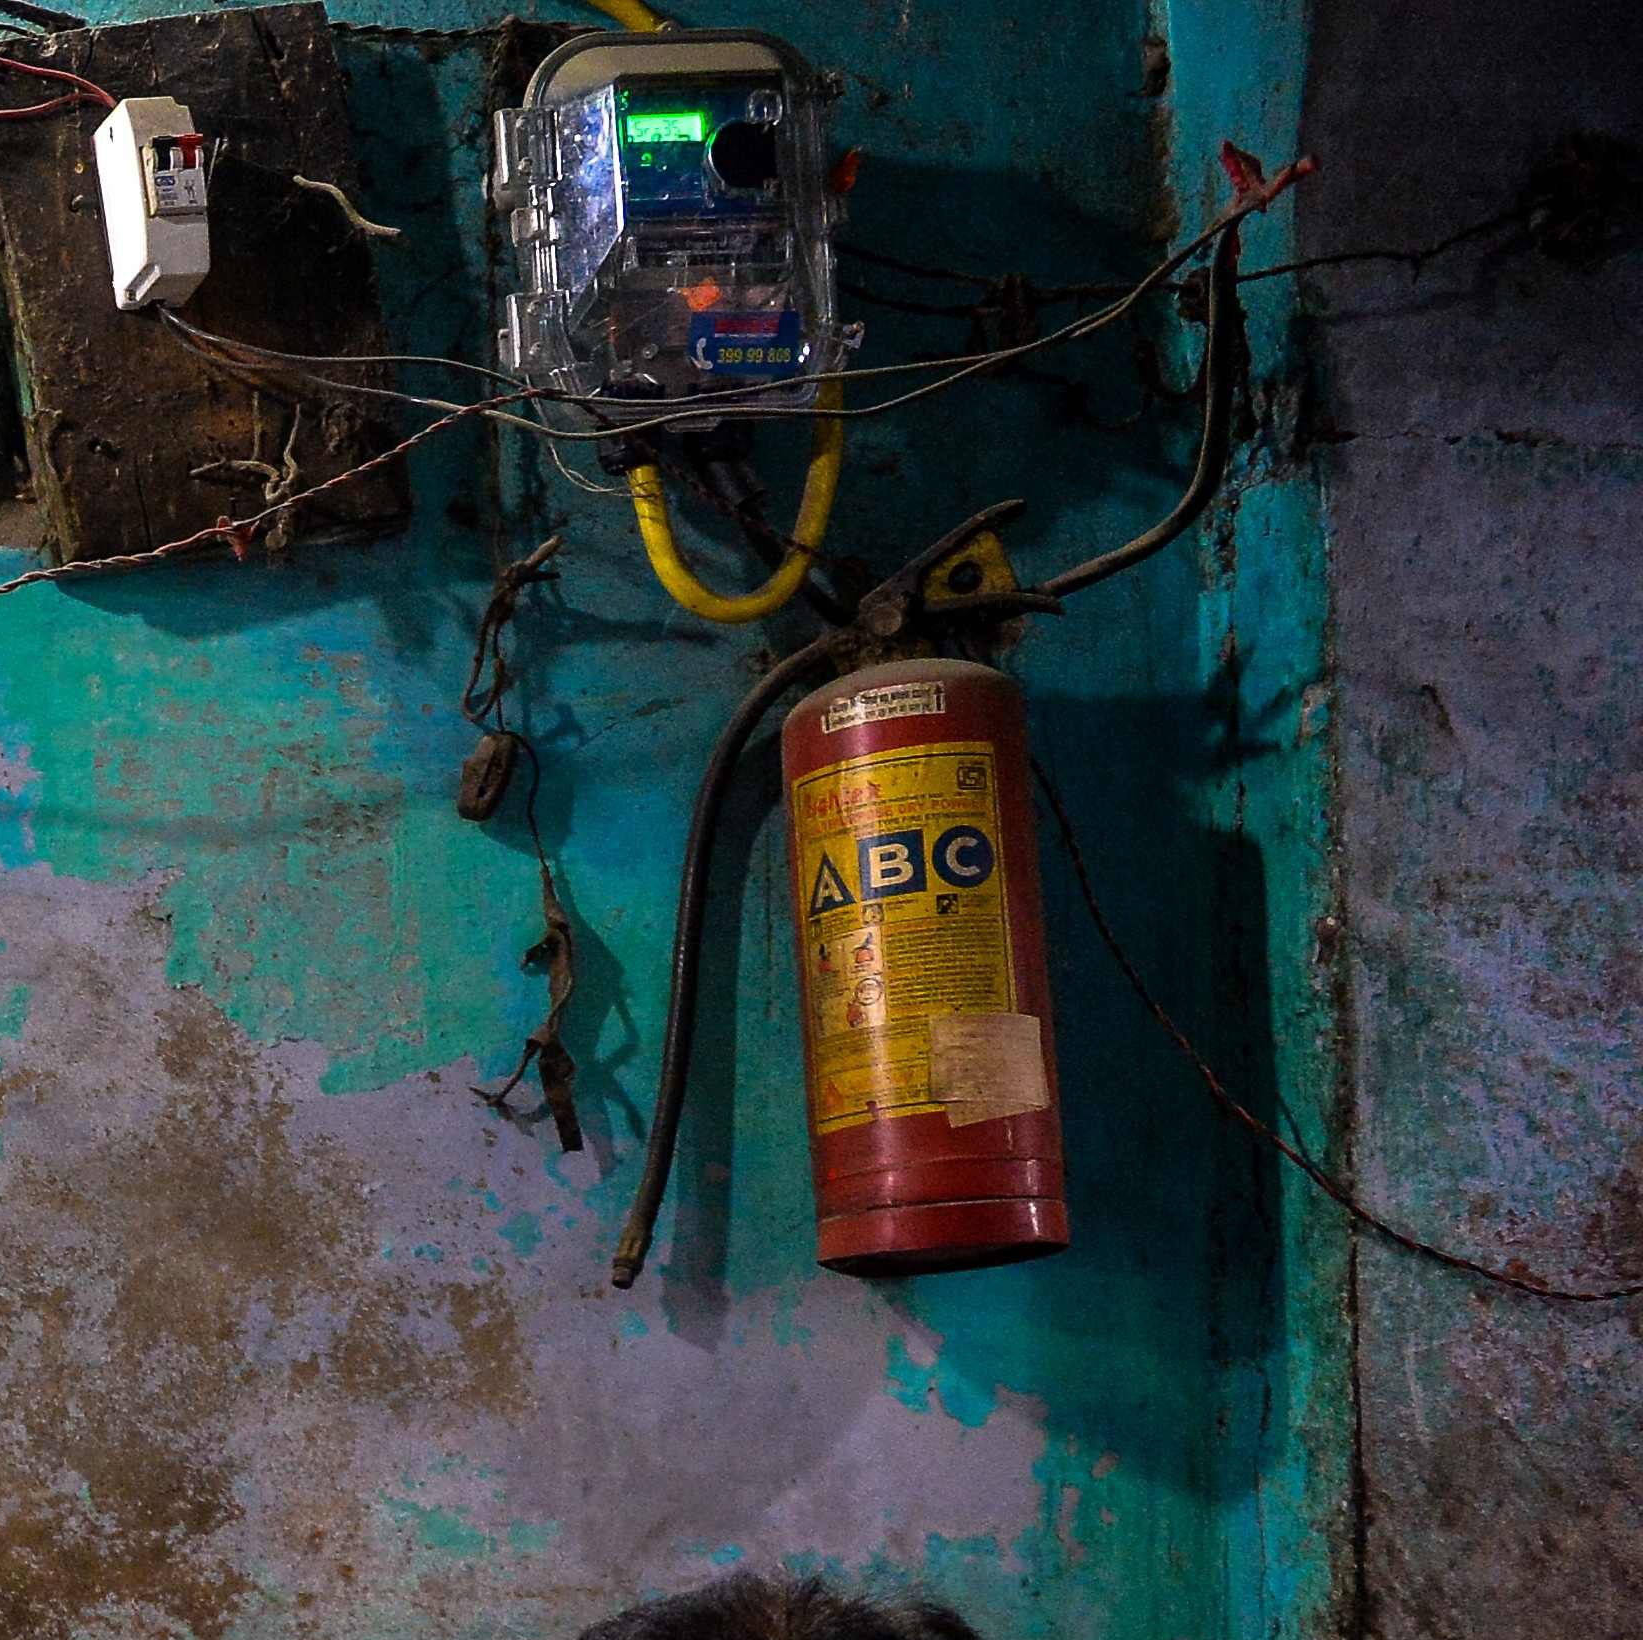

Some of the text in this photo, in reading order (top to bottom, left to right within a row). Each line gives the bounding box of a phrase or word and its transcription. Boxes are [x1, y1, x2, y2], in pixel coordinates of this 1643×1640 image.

[816, 836, 980, 908] A B C
